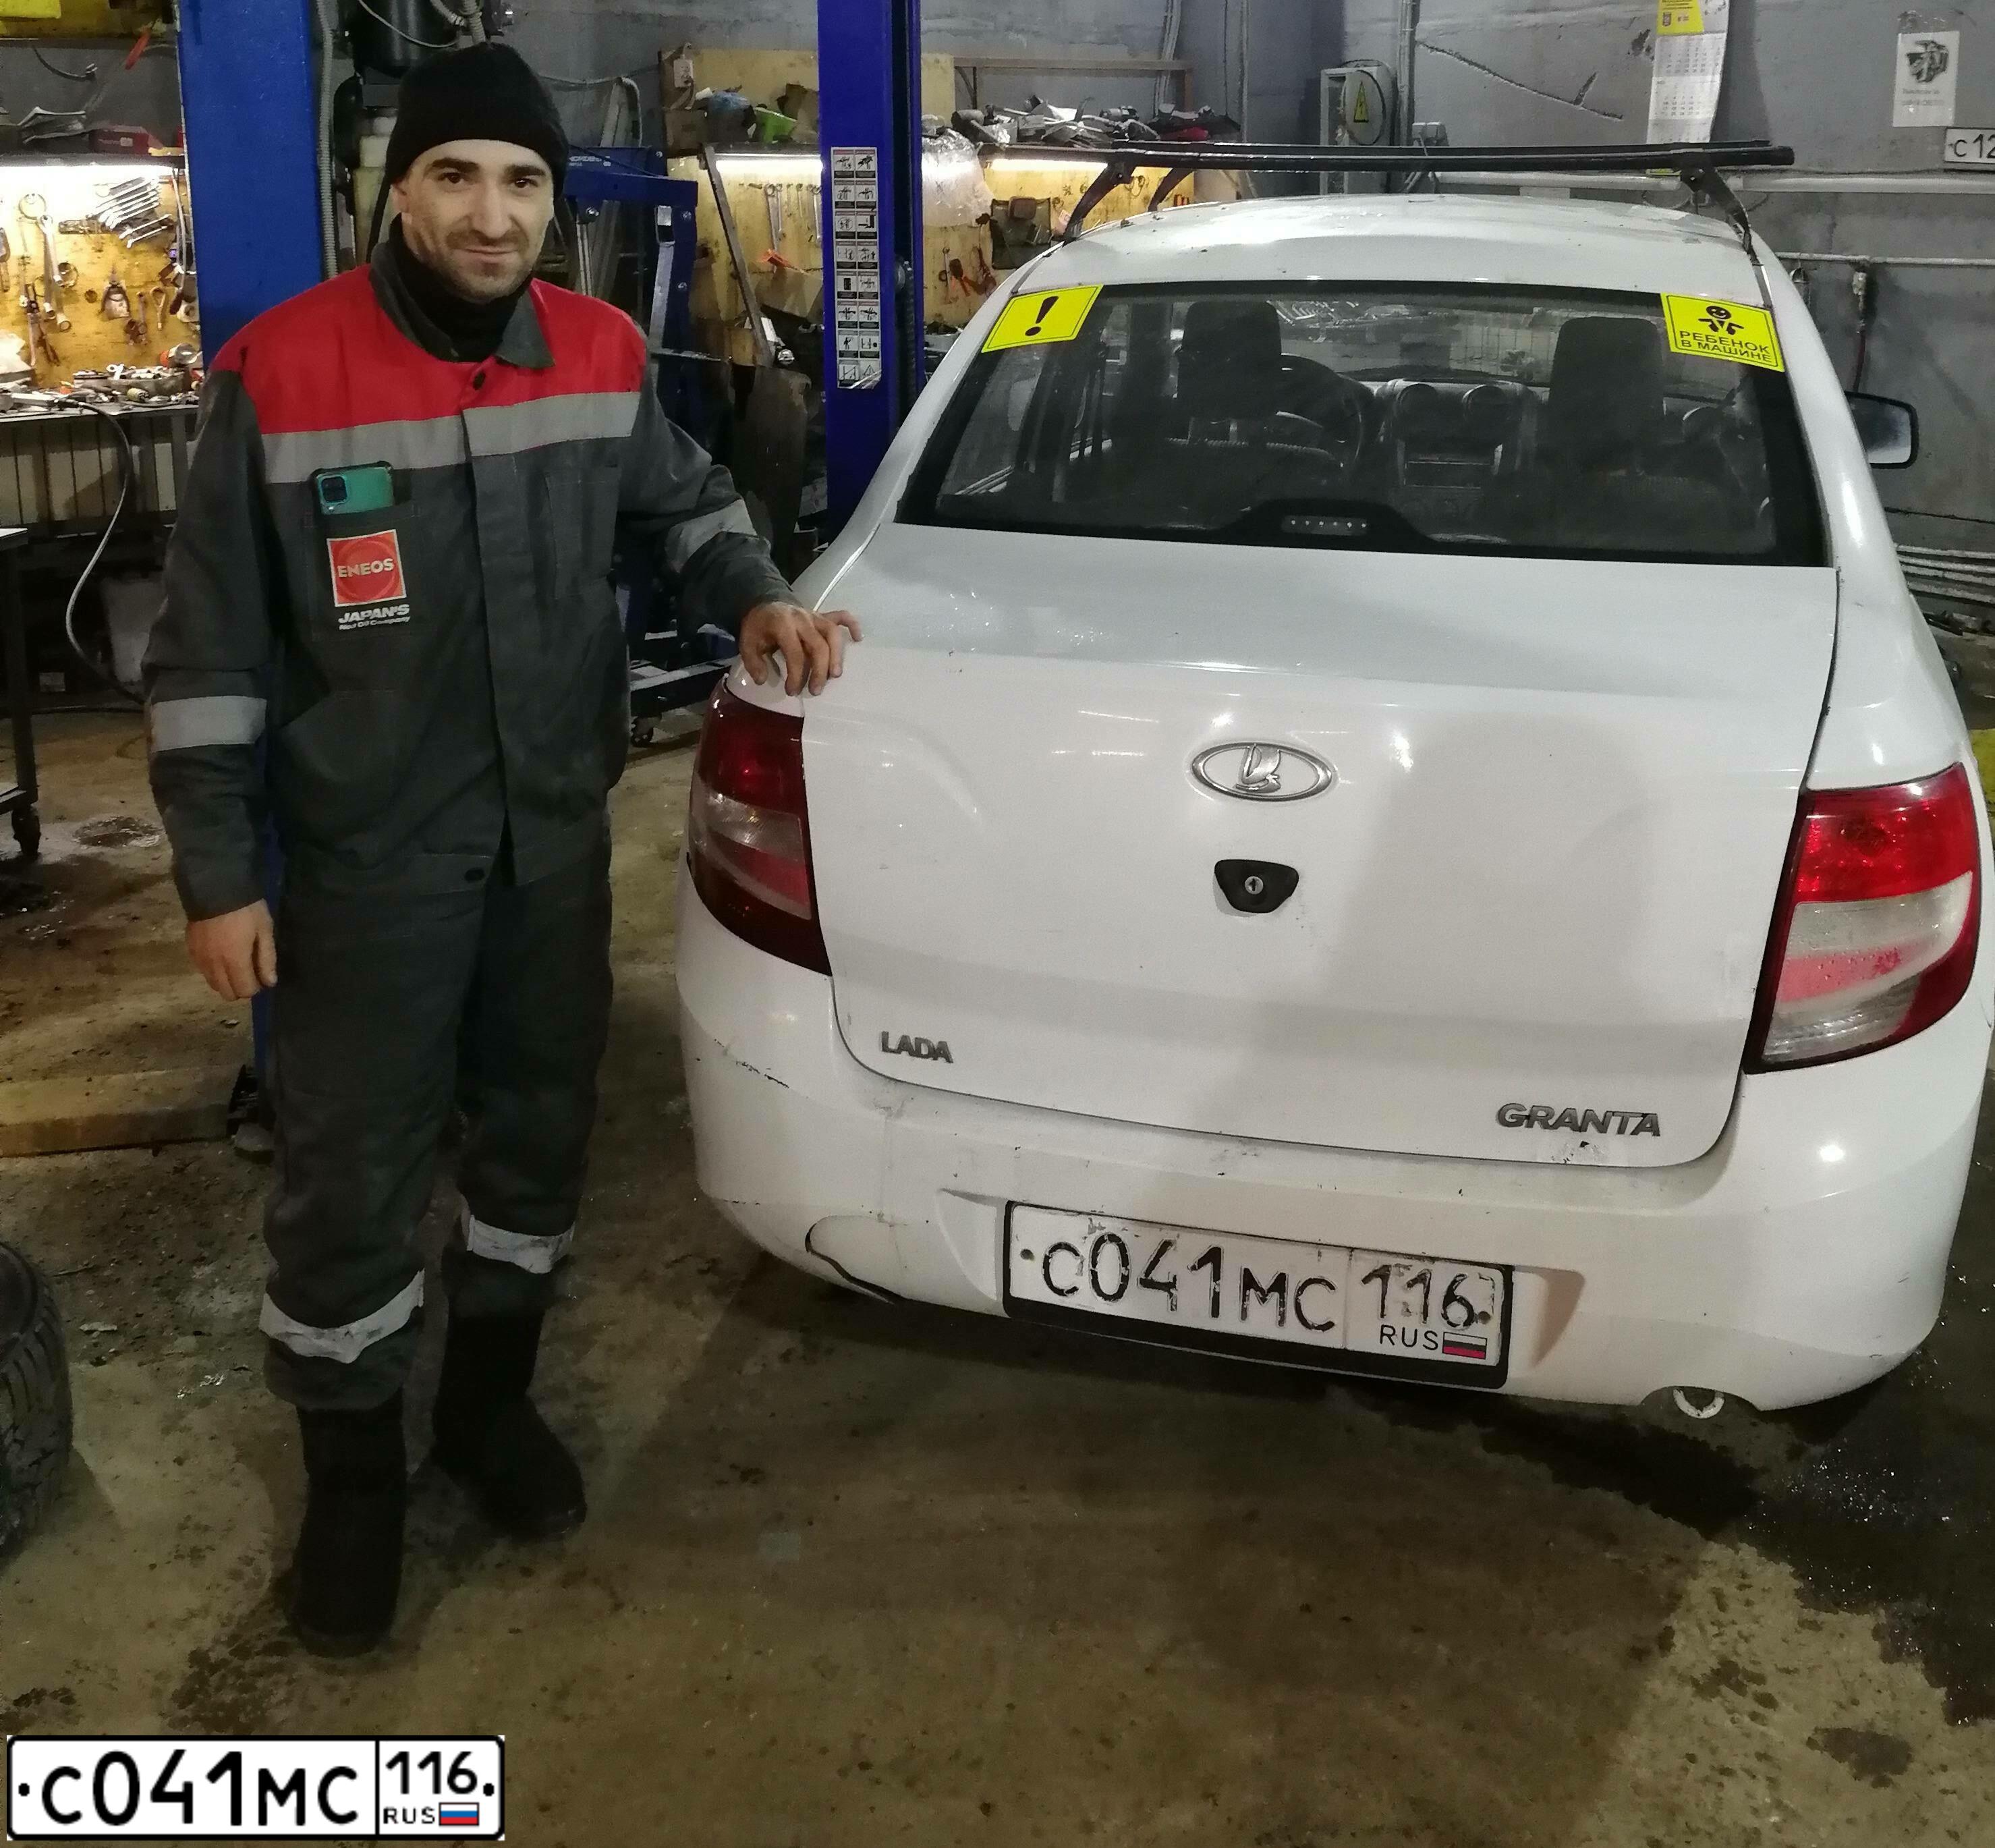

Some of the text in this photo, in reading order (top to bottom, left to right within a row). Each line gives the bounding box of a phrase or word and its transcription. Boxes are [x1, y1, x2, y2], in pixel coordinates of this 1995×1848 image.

[1679, 331, 1770, 354] РЕБЕНОК
[1681, 339, 1772, 363] В МАШИНЕ
[337, 558, 395, 578] ENEOS
[338, 604, 410, 623] JAPAN'S
[881, 1030, 953, 1063] LADA
[1496, 1102, 1661, 1136] GRANTA
[1361, 1264, 1476, 1331] 116
[1380, 1324, 1438, 1350] RUS
